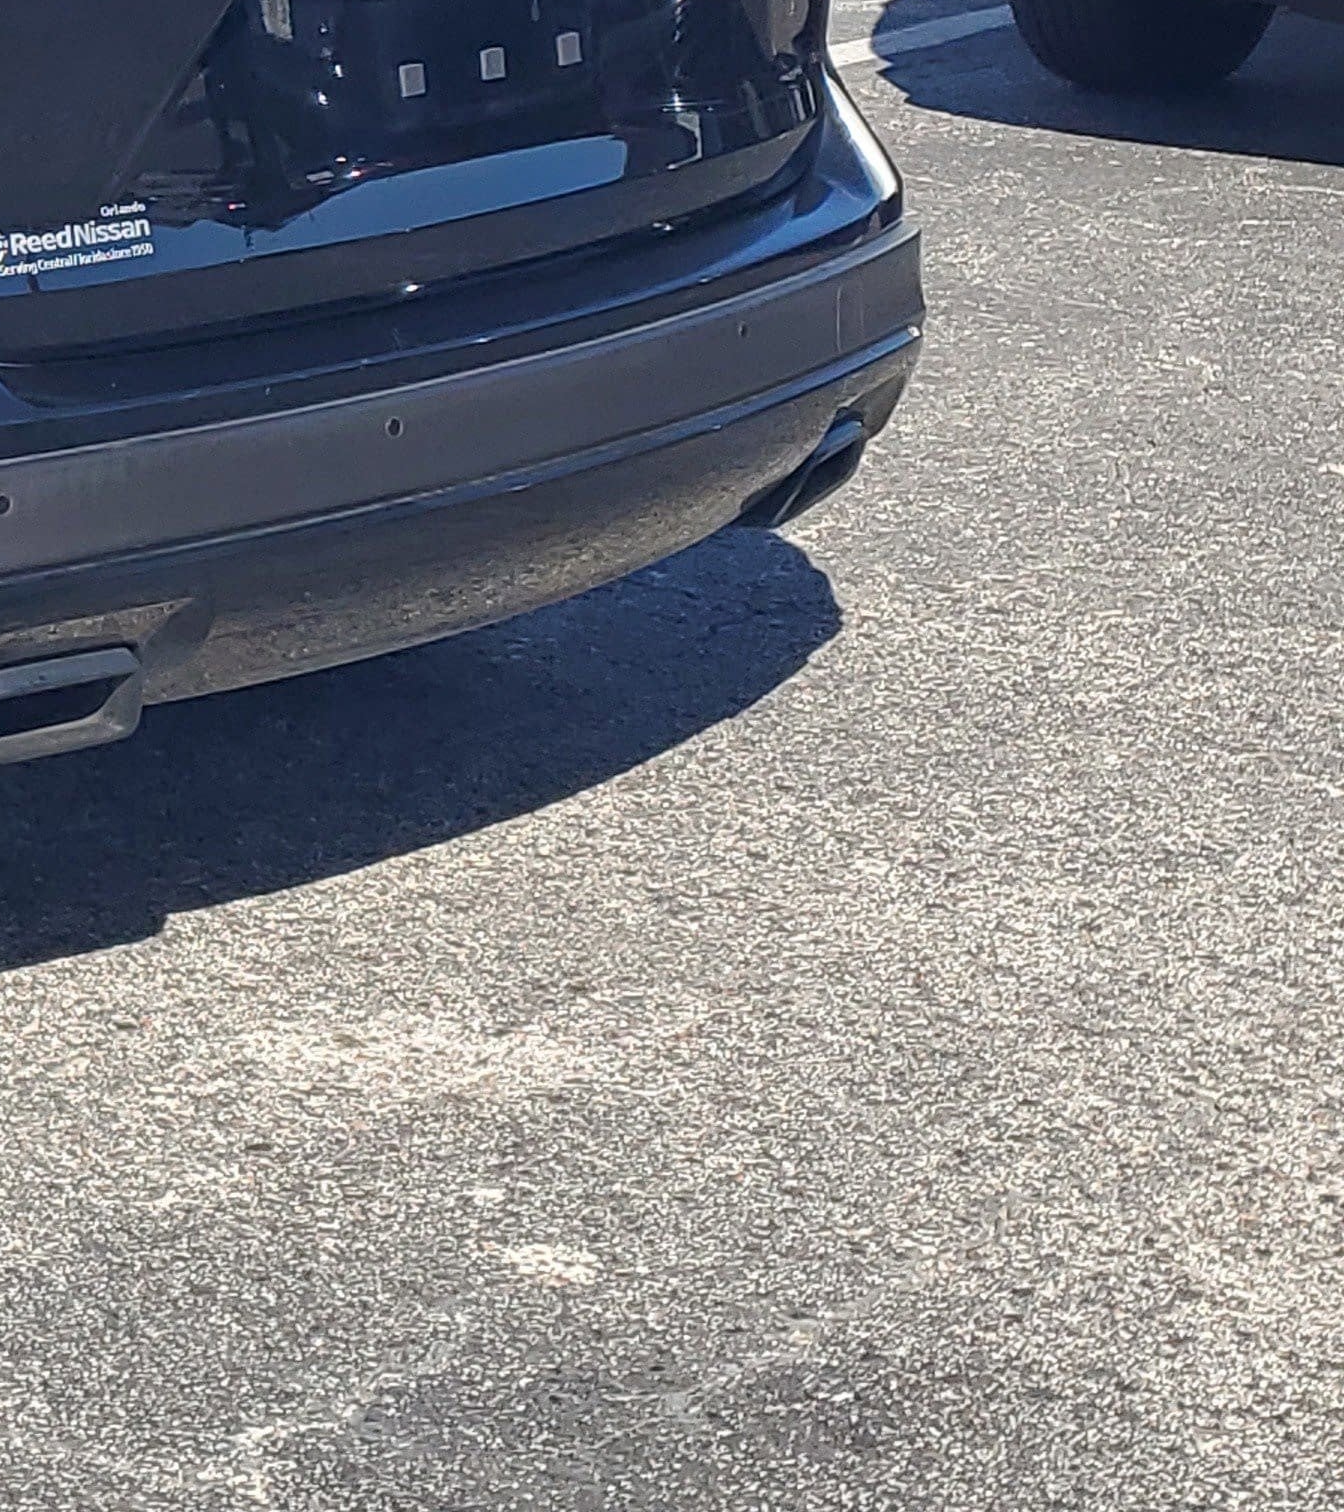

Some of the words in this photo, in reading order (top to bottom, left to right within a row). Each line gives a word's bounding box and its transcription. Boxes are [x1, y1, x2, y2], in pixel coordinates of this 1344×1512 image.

[100, 201, 146, 217] Orlando
[10, 224, 71, 256] Reed
[73, 218, 151, 247] Nissan
[38, 255, 73, 270] Central
